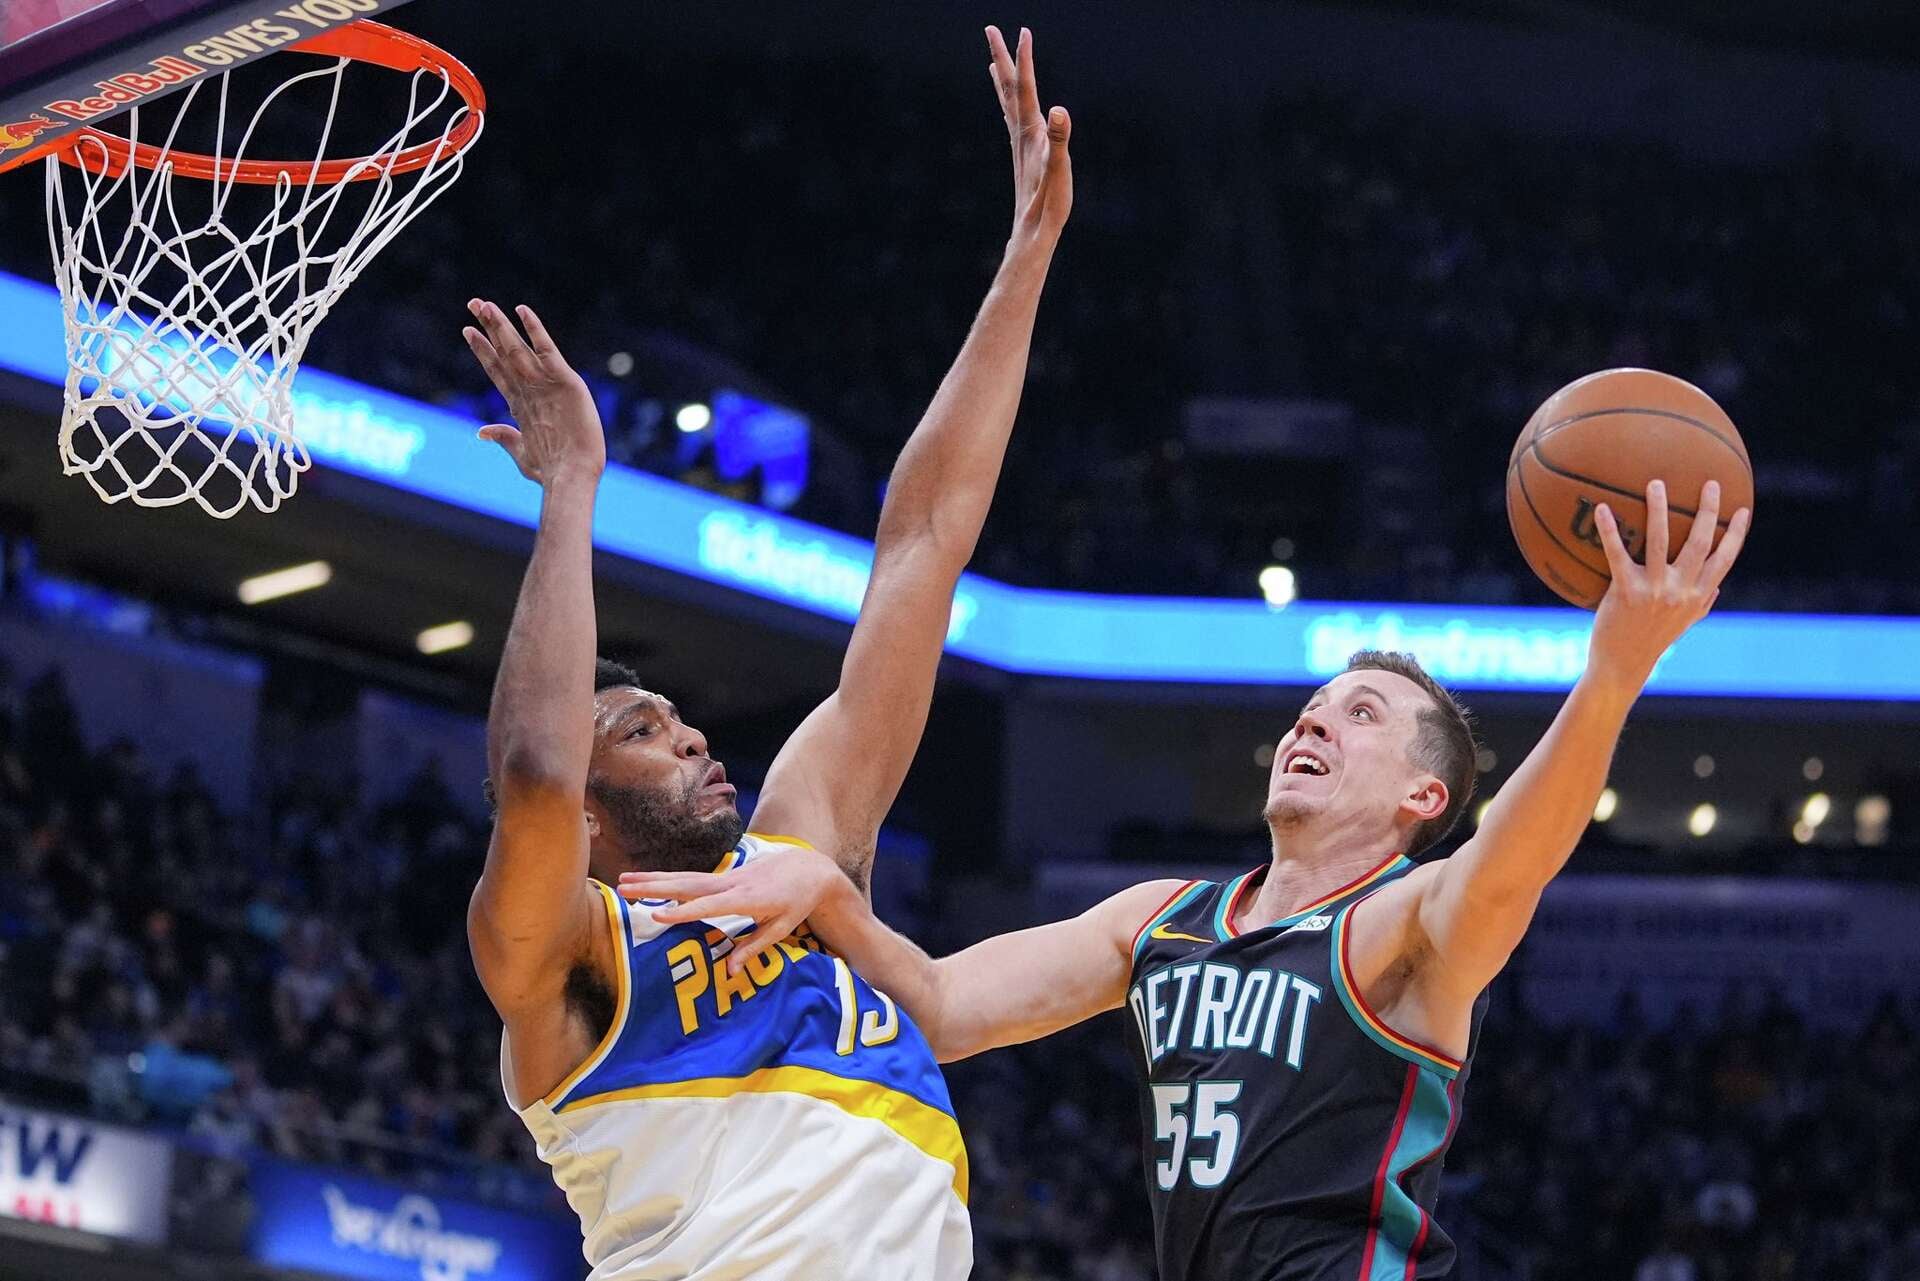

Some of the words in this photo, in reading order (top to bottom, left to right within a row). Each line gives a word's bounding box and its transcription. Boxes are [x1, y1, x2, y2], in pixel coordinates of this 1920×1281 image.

[183, 18, 300, 66] GIVES
[275, 0, 379, 29] YOU
[1129, 960, 1322, 1074] DETROIT
[1150, 1080, 1243, 1191] 55
